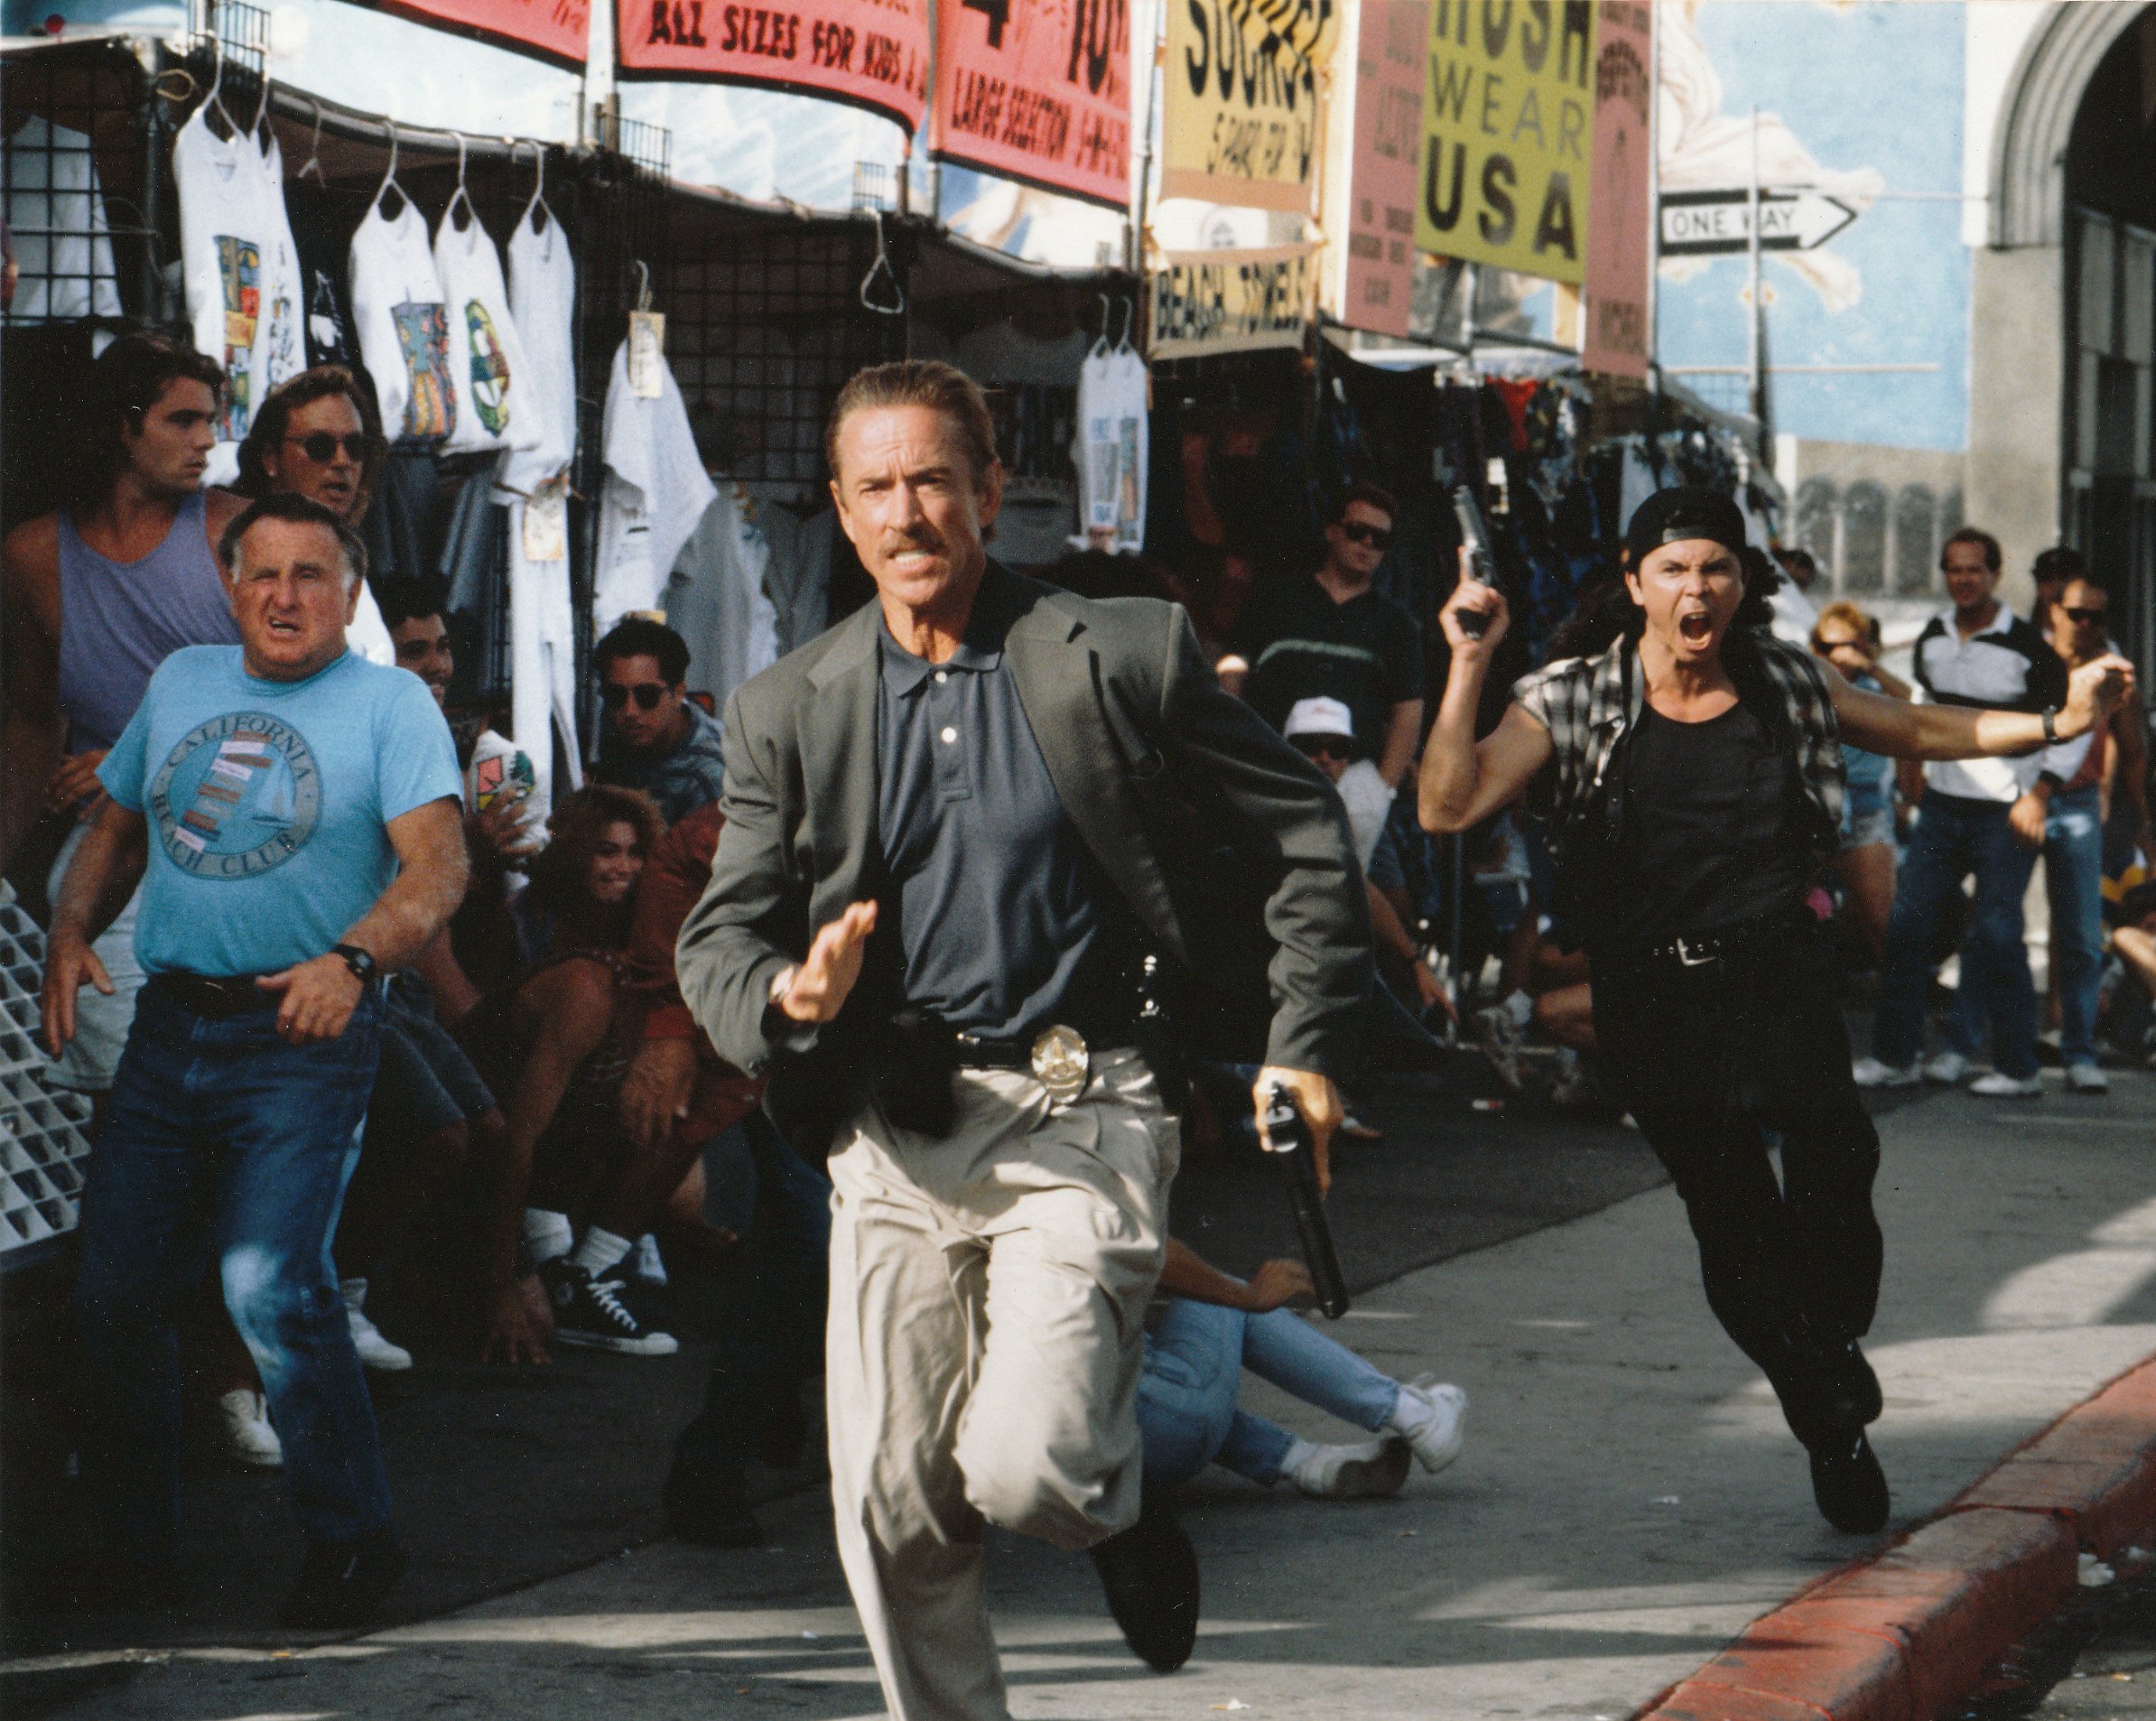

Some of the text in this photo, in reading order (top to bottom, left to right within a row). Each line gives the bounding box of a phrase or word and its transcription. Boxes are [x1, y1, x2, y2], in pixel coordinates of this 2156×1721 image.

[647, 0, 707, 47] ALL
[721, 5, 802, 60] SIZES
[813, 18, 855, 72] FOR
[1431, 52, 1585, 161] WEAR
[1425, 134, 1578, 262] USA
[1671, 209, 1728, 237] ONE
[167, 715, 313, 782] CALIFORNIA
[220, 833, 299, 875] CLUB
